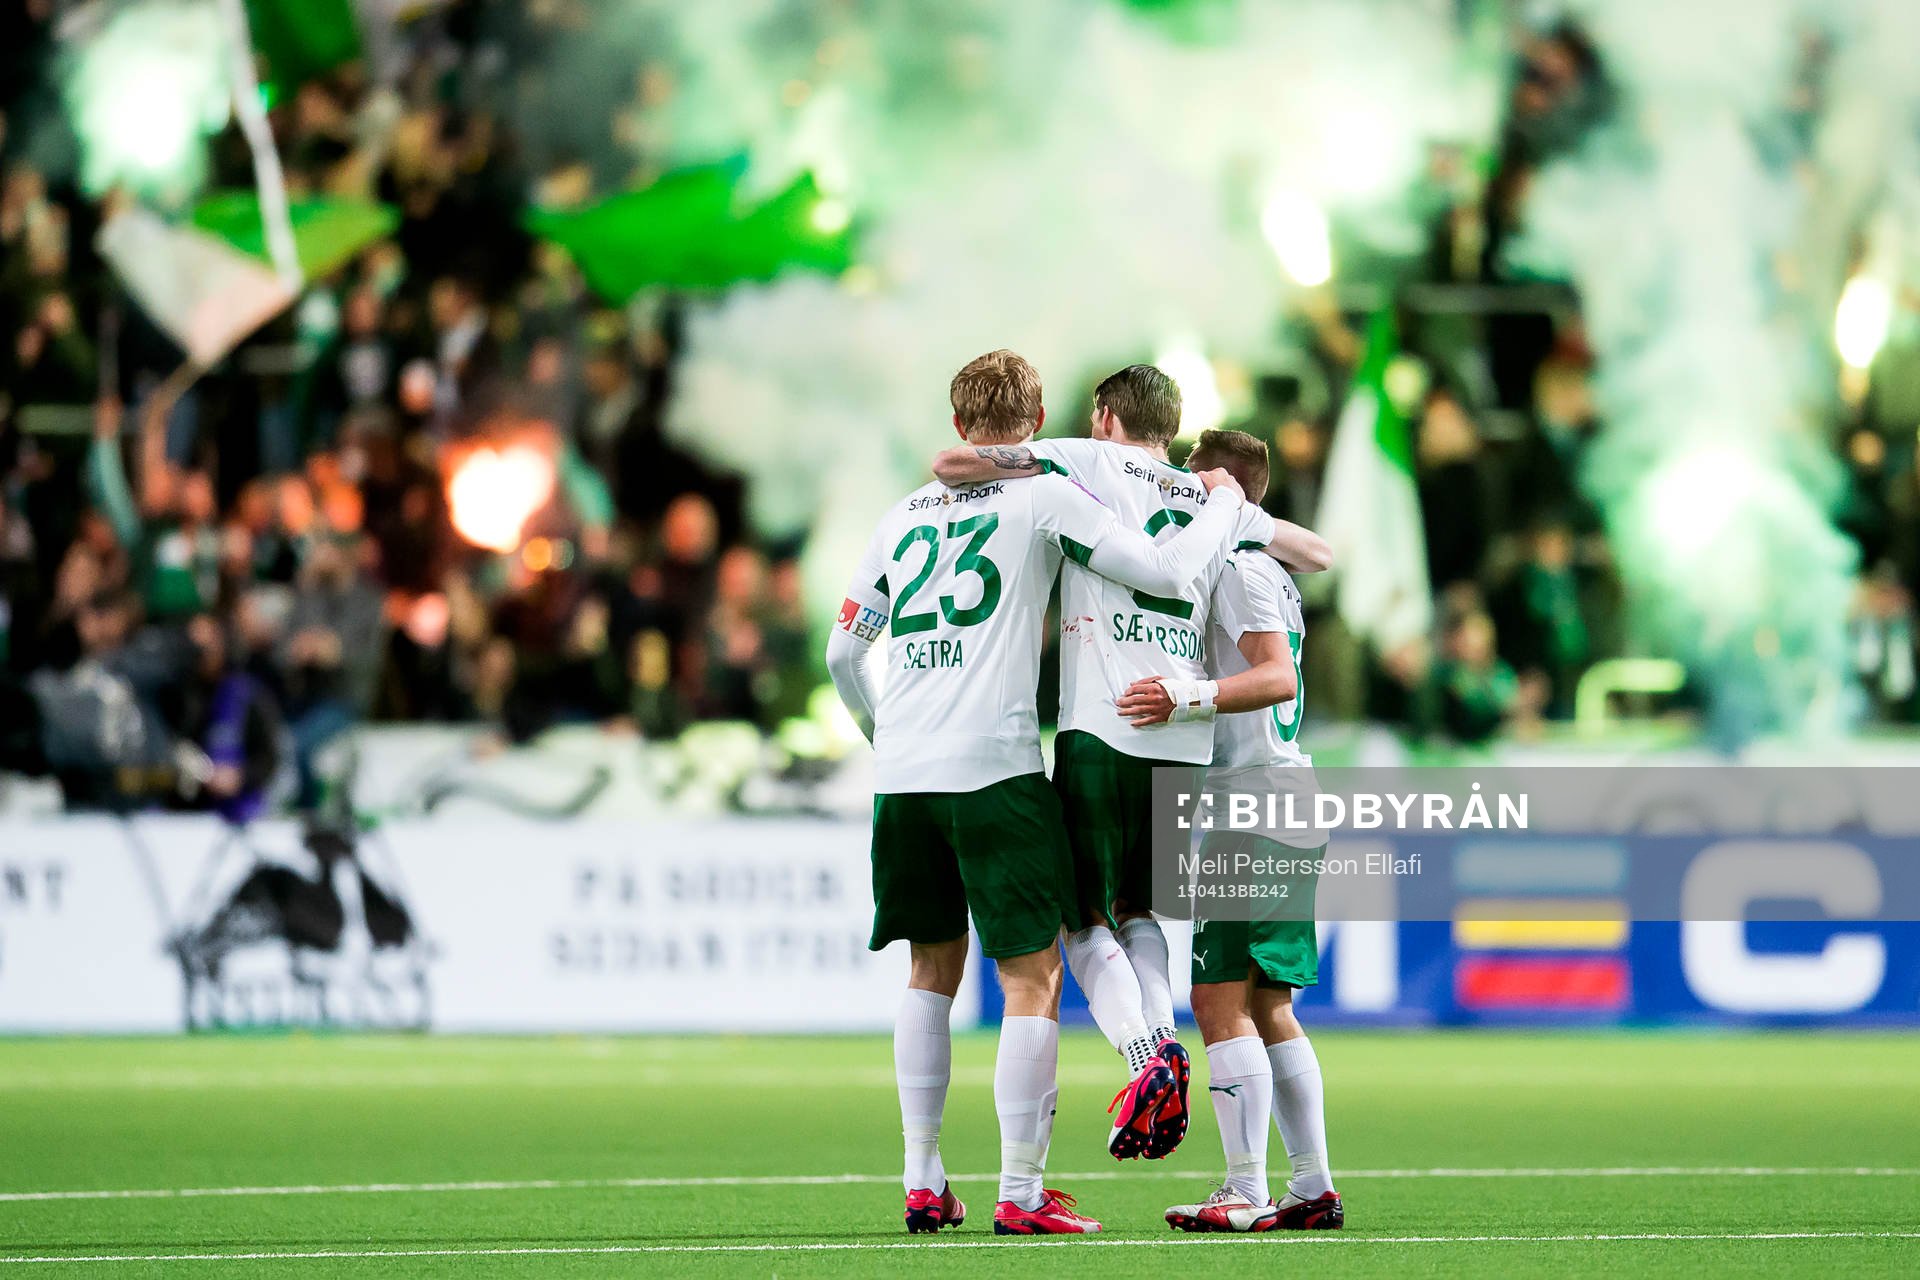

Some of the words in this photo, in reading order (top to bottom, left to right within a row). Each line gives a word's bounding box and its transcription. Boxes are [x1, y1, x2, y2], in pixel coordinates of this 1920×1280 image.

[890, 511, 1002, 639] 23
[904, 639, 964, 670] SÆTRA
[1112, 613, 1204, 662] SÆVRSSON
